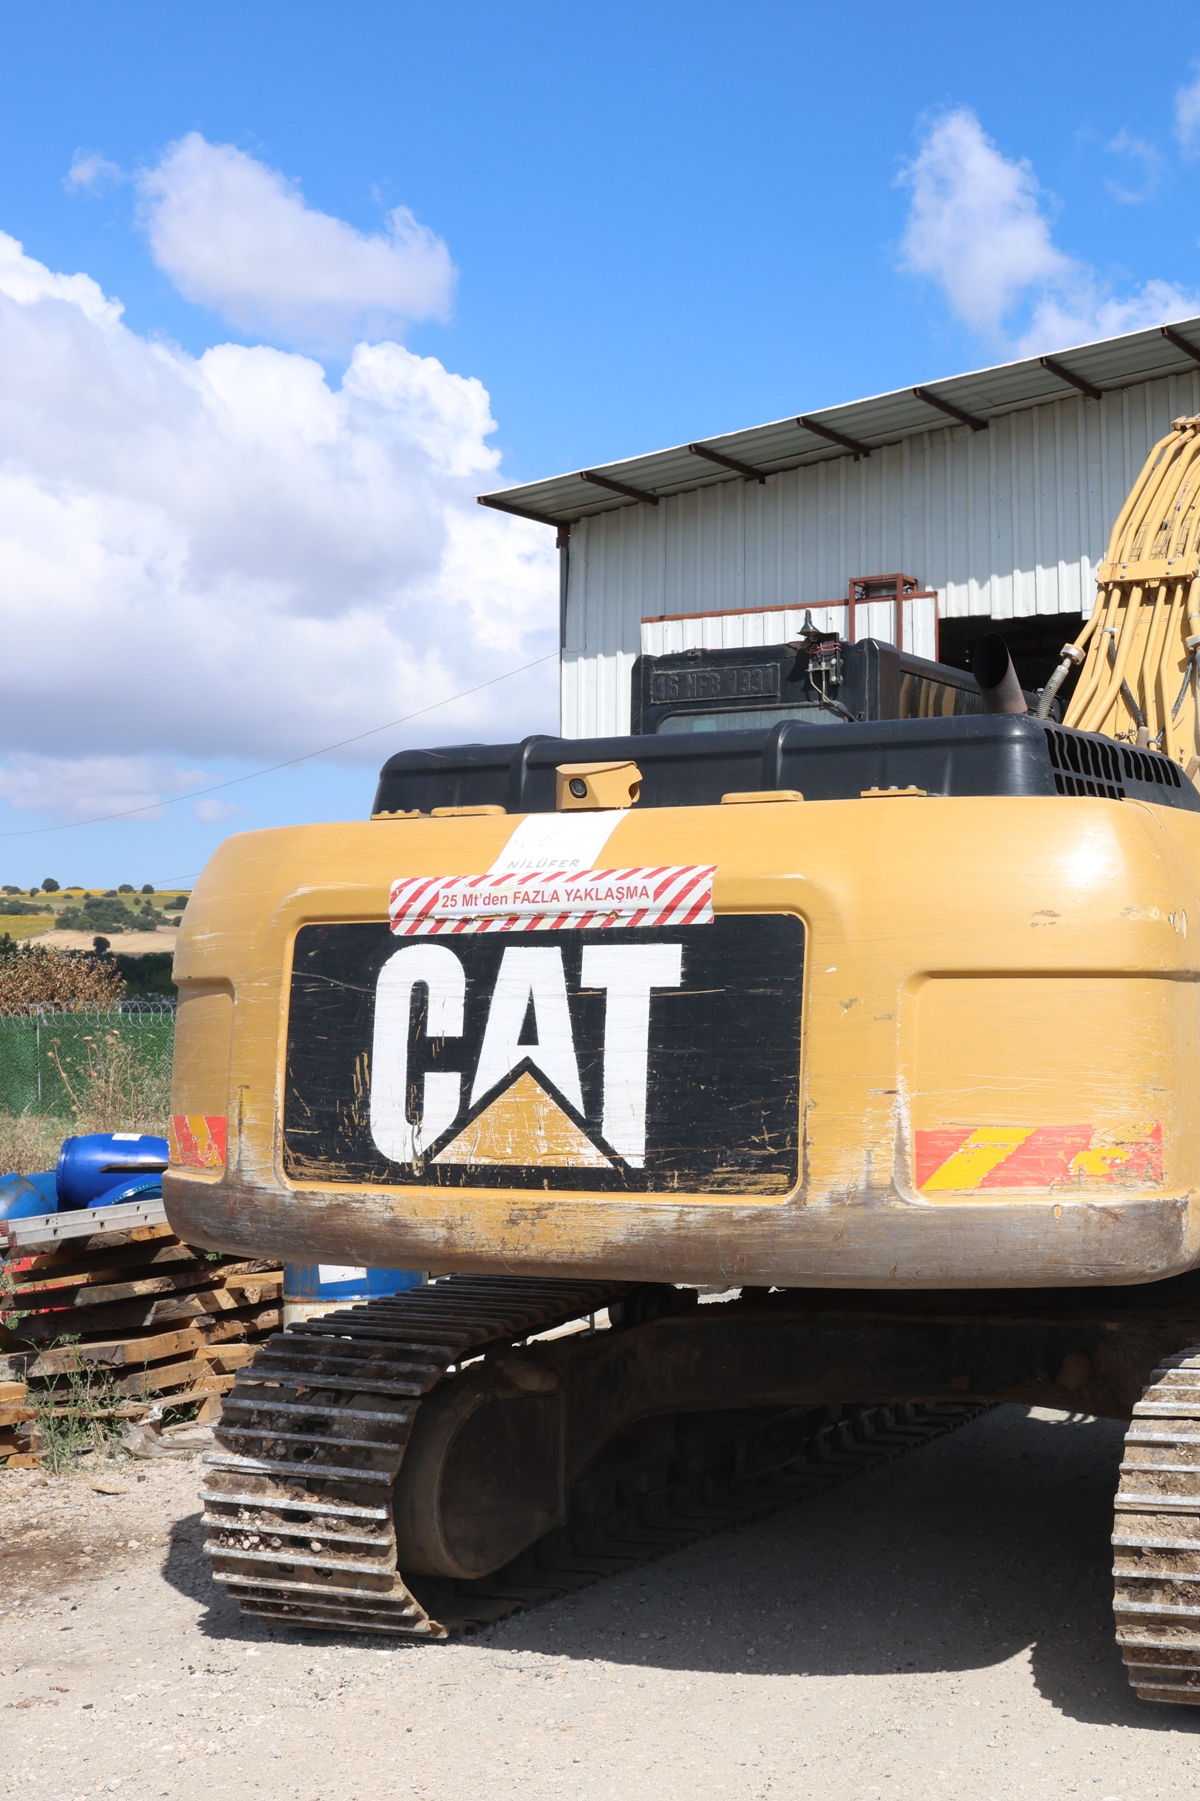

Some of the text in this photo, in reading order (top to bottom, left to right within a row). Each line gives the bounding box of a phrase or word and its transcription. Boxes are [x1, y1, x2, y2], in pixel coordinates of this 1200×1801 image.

[657, 675, 679, 700] 16
[685, 672, 721, 698] NFB
[507, 858, 580, 870] NİLÜFER
[441, 885, 650, 908] 25 Mt'den FAZLA YAKLAŞMA
[370, 943, 683, 1168] CAT
